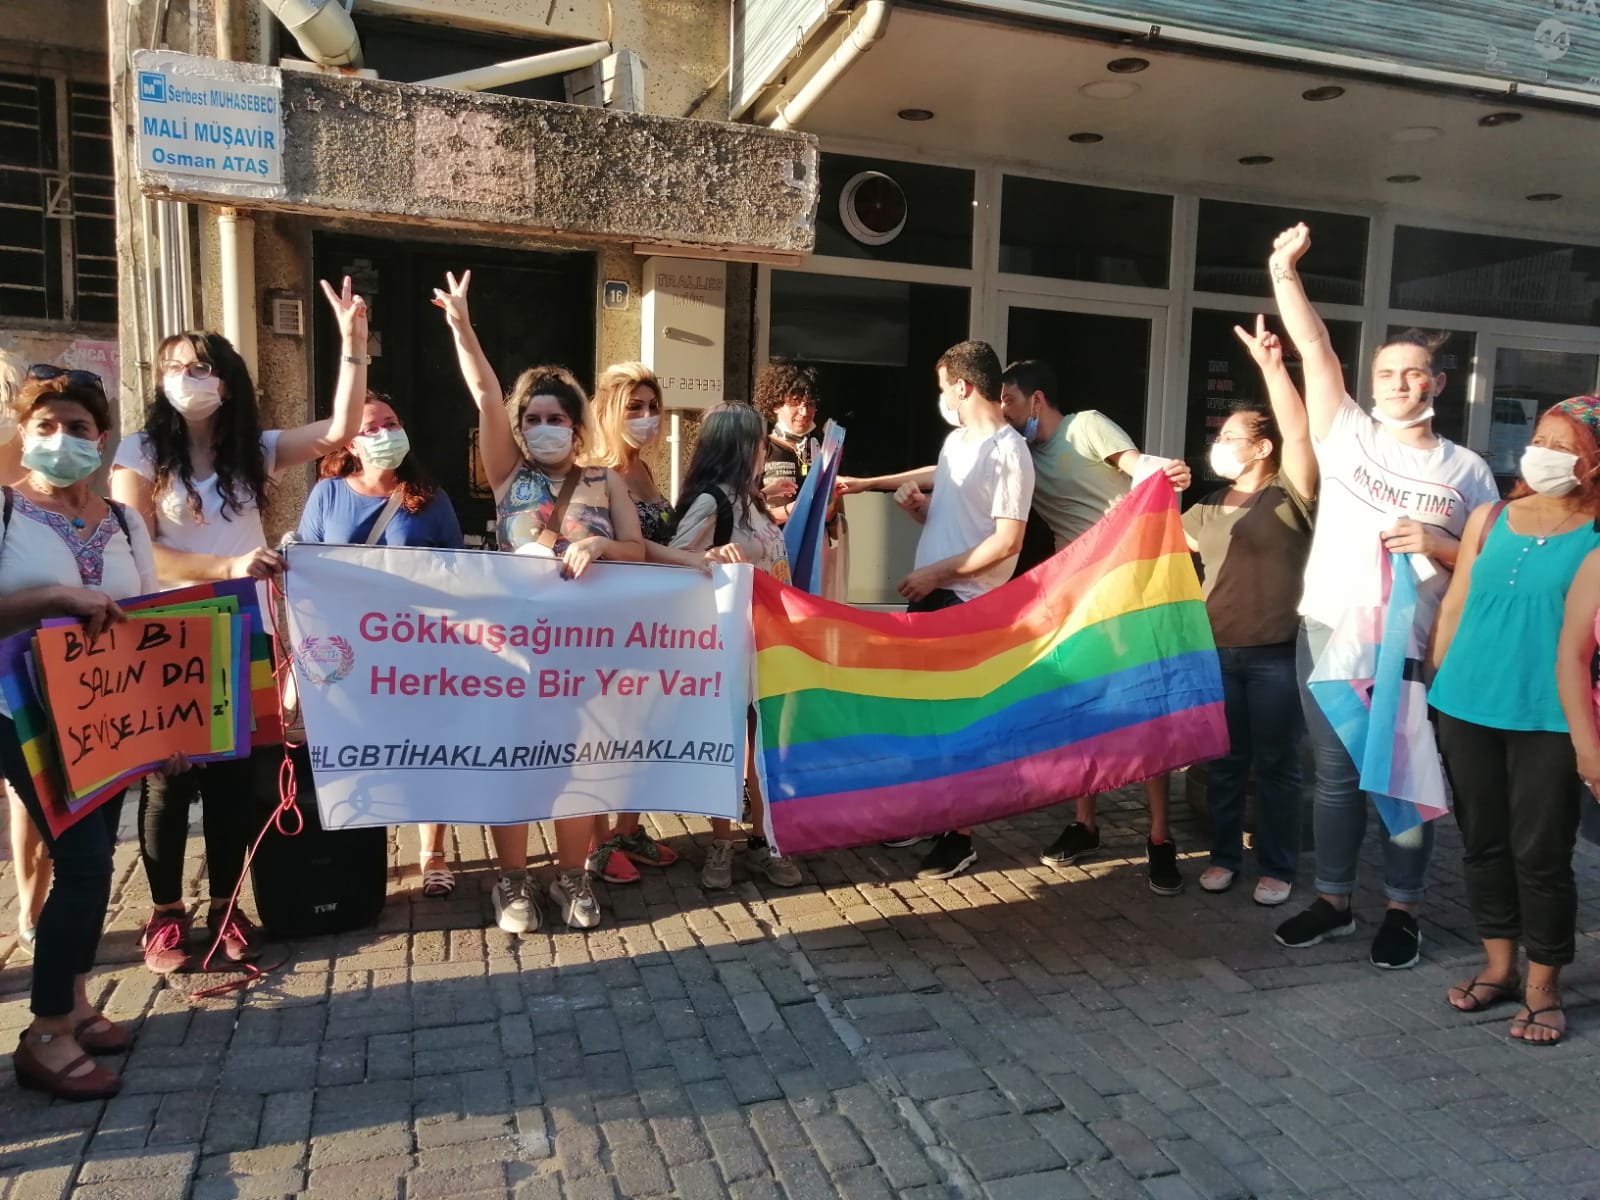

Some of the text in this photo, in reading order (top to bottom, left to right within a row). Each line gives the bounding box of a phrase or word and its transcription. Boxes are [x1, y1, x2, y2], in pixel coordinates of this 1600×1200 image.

[168, 84, 207, 106] Serbest
[143, 116, 275, 150] MALİ MÜŞAVİR
[152, 147, 269, 178] Osman ATAŞ
[610, 289, 623, 303] 16
[1353, 465, 1456, 518] MARINE TIME
[359, 612, 614, 655] Gökkuşağının
[624, 621, 724, 651] Altınd
[162, 656, 205, 687] DA
[370, 665, 722, 698] Herkese Bir Yer Var!
